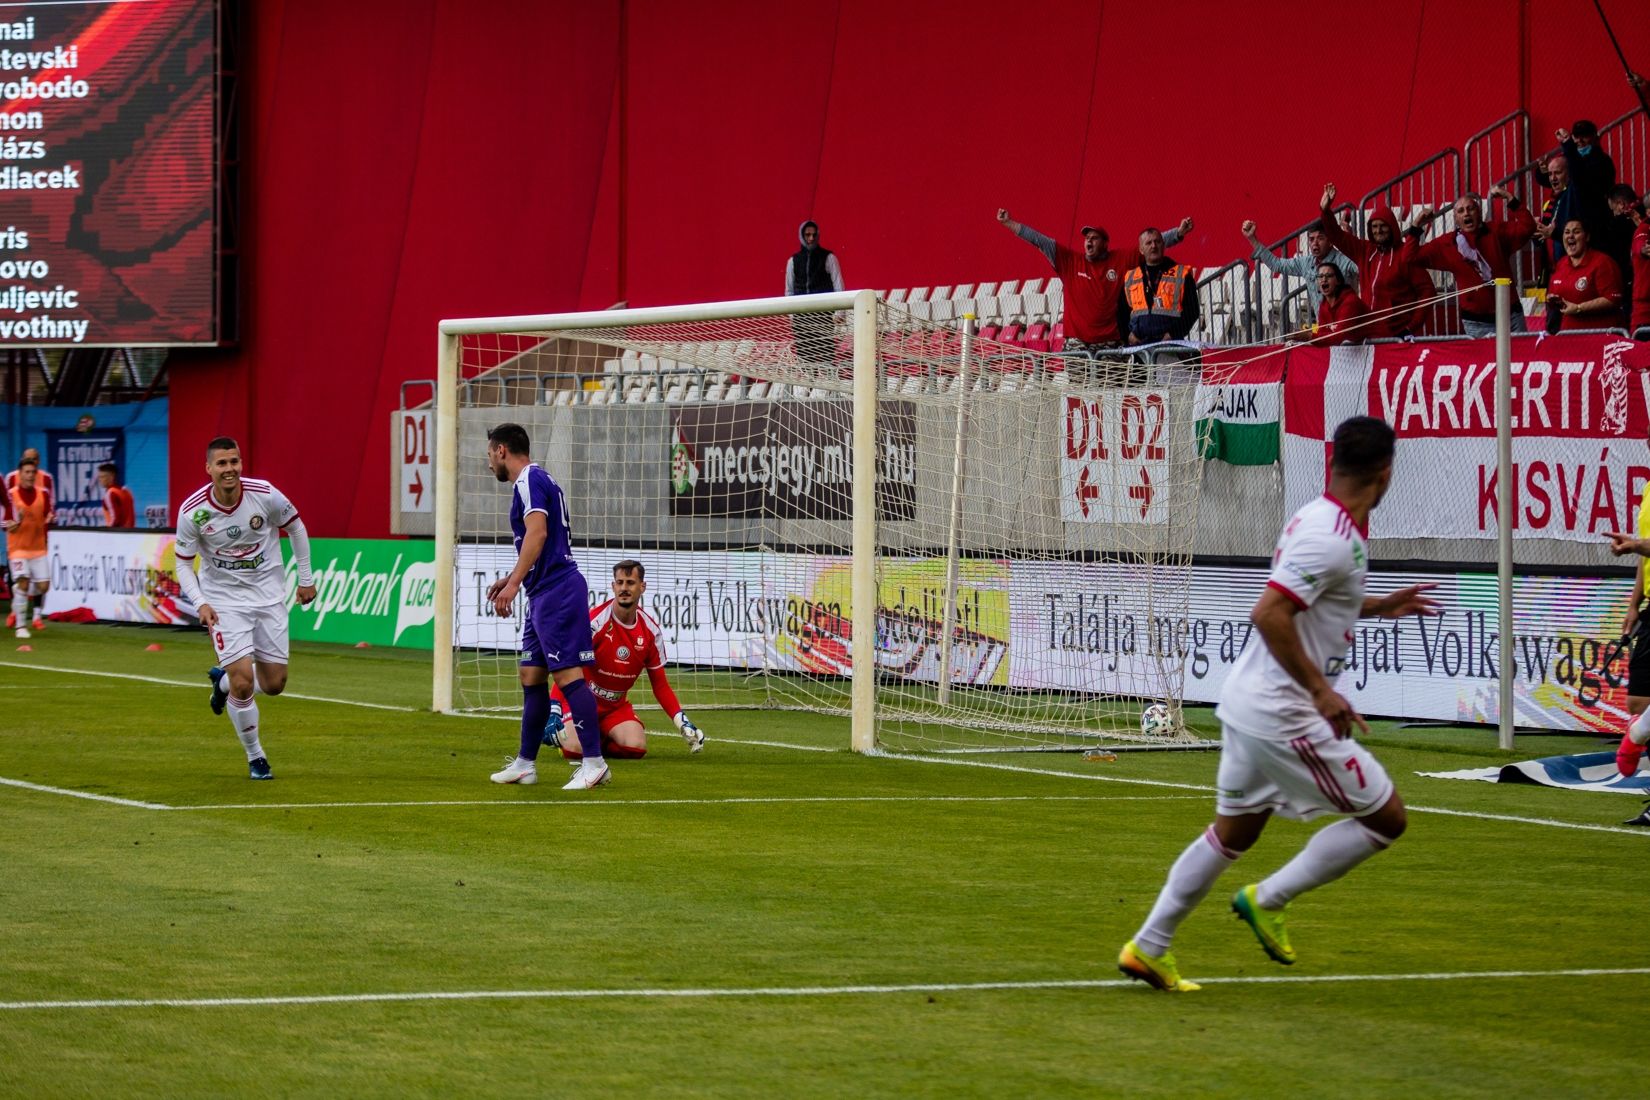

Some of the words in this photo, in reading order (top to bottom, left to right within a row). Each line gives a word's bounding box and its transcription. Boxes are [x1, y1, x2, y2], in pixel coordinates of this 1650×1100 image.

[0, 45, 78, 70] tevski
[1379, 349, 1594, 431] VÁRKERTI
[404, 415, 430, 464] D1
[1067, 394, 1108, 460] D1
[1121, 393, 1166, 460] D2
[52, 545, 69, 592] Ön
[72, 554, 99, 603] saját
[215, 631, 225, 651] 9
[1043, 593, 1138, 673] Találja
[1147, 615, 1210, 680] meg
[1344, 757, 1367, 790] 7
